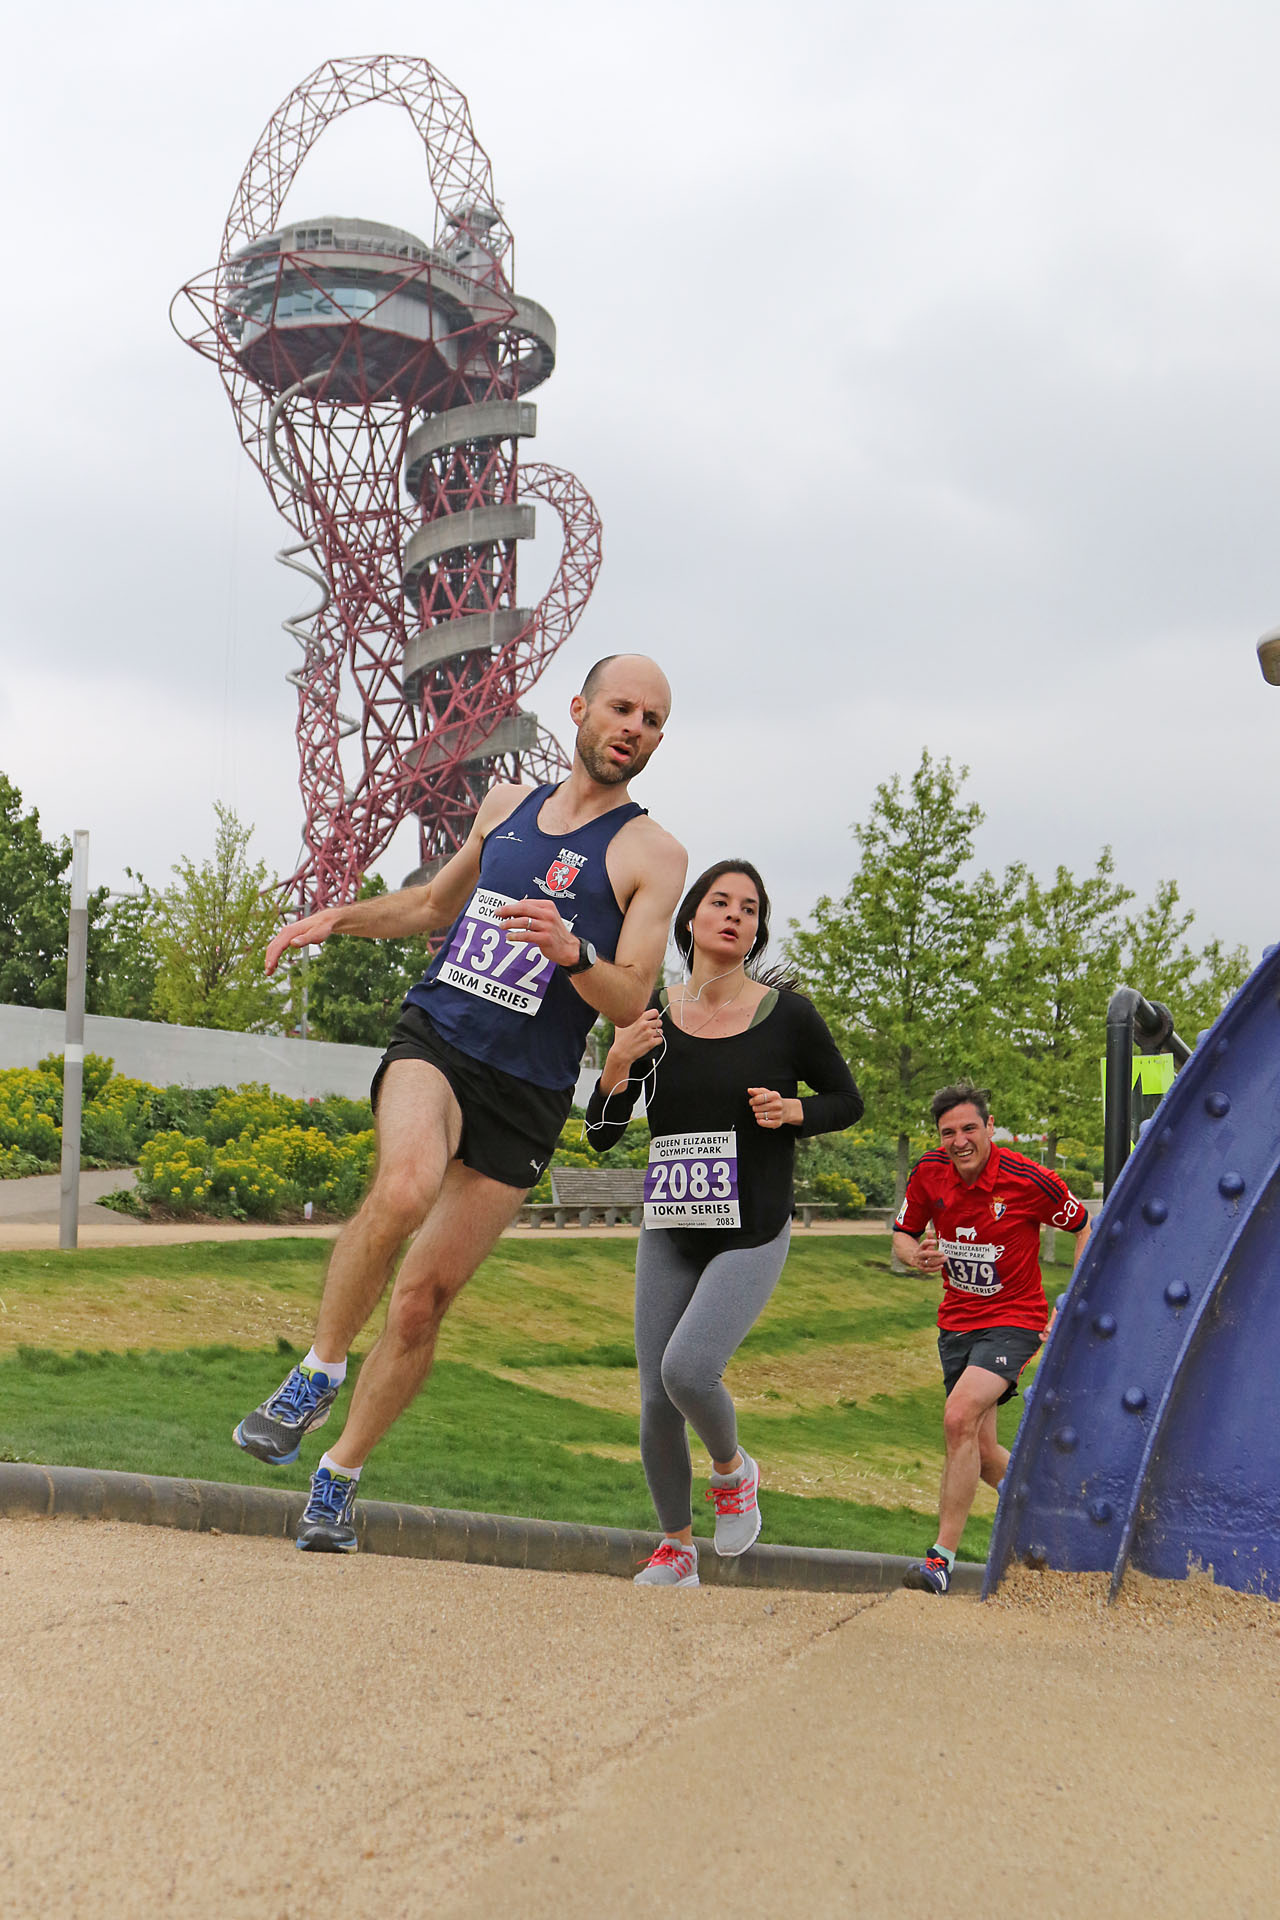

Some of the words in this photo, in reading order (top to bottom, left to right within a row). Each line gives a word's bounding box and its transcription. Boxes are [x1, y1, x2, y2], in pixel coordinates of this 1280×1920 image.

[557, 848, 588, 865] KENT
[478, 894, 507, 908] QUEEN
[456, 922, 550, 992] 1372
[447, 968, 479, 990] 10KM
[482, 983, 530, 1009] SERIES
[655, 1138, 680, 1149] QUEEN
[683, 1136, 729, 1146] ELIZABETH
[660, 1147, 694, 1157] OLYMPIC
[697, 1146, 722, 1154] PARK
[650, 1161, 732, 1200] 2083
[653, 1205, 687, 1216] 10KM
[691, 1203, 731, 1215] SERIES
[716, 1217, 735, 1226] 2083
[944, 1249, 968, 1258] OLYMPIC
[959, 1245, 990, 1253] ELIZABETH
[947, 1259, 994, 1285] 1379
[971, 1286, 997, 1294] SERIES
